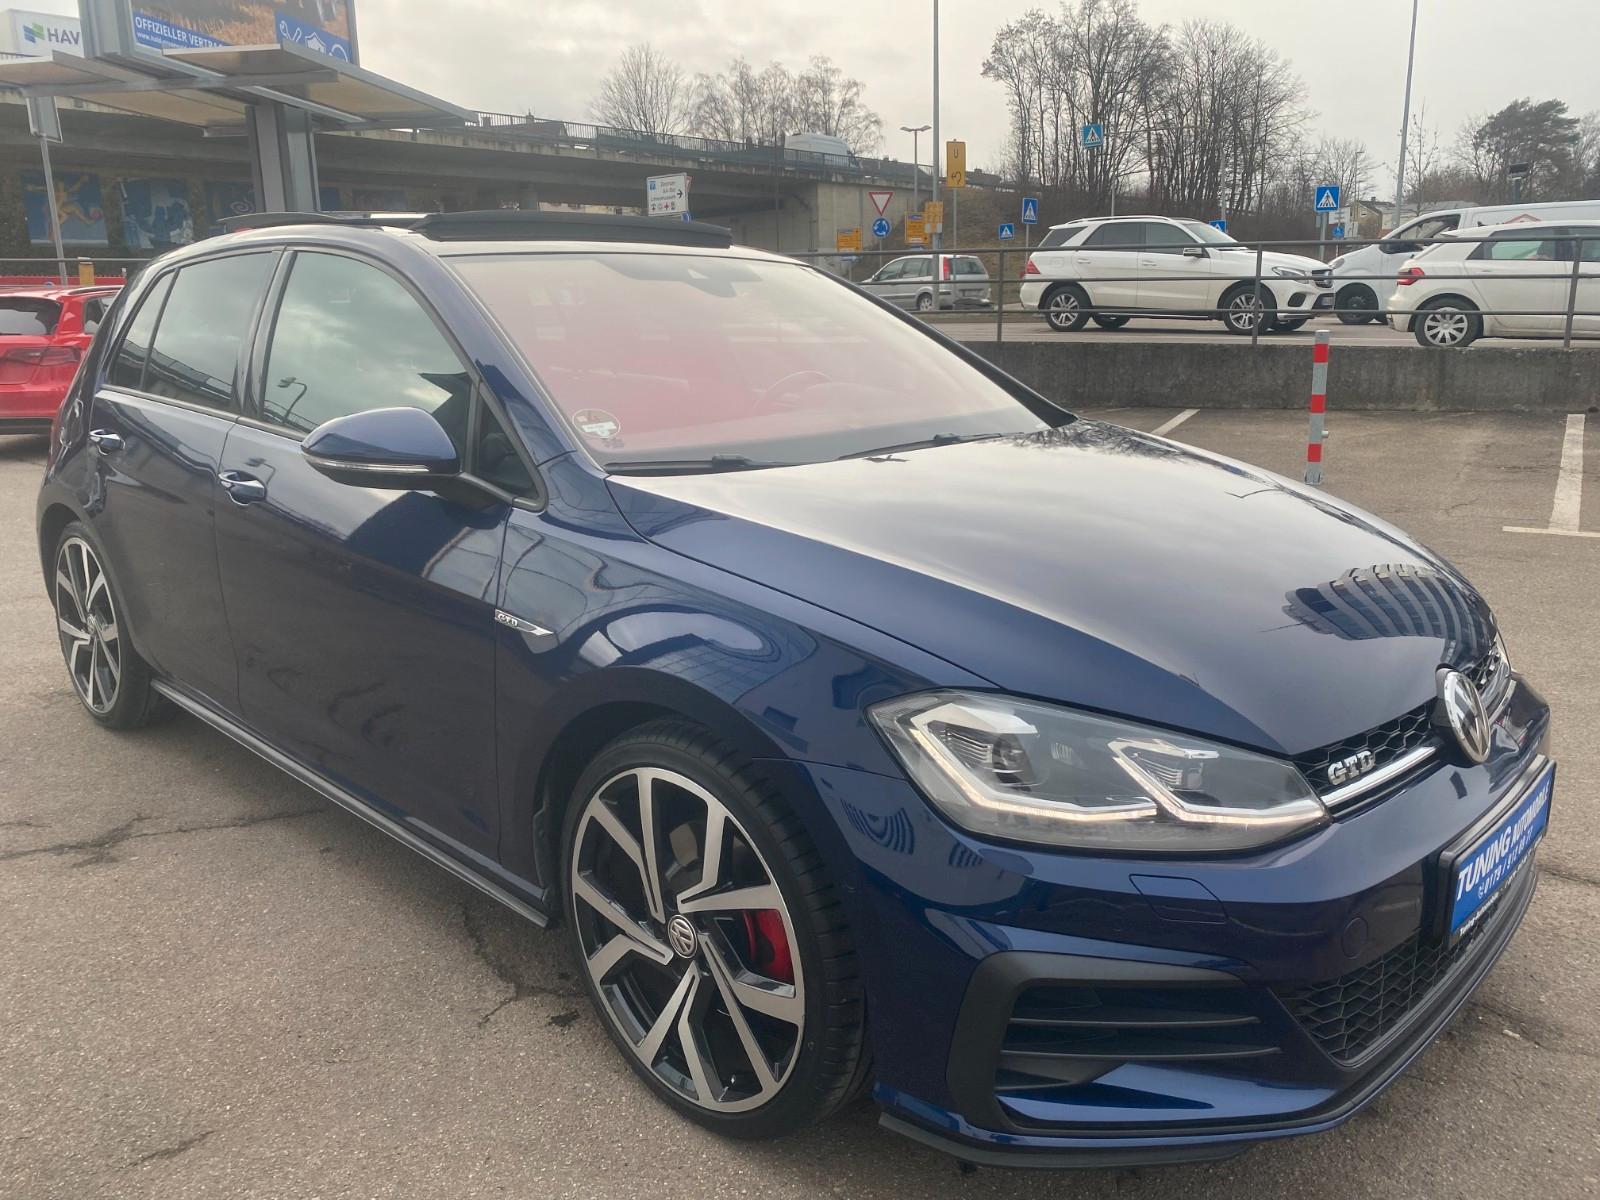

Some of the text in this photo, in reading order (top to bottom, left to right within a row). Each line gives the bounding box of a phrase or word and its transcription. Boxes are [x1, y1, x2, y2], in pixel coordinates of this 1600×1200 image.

[135, 17, 188, 43] OFFIZIELLER
[497, 613, 518, 627] GTD
[1328, 751, 1376, 785] GTD
[1457, 825, 1512, 902] TUNING
